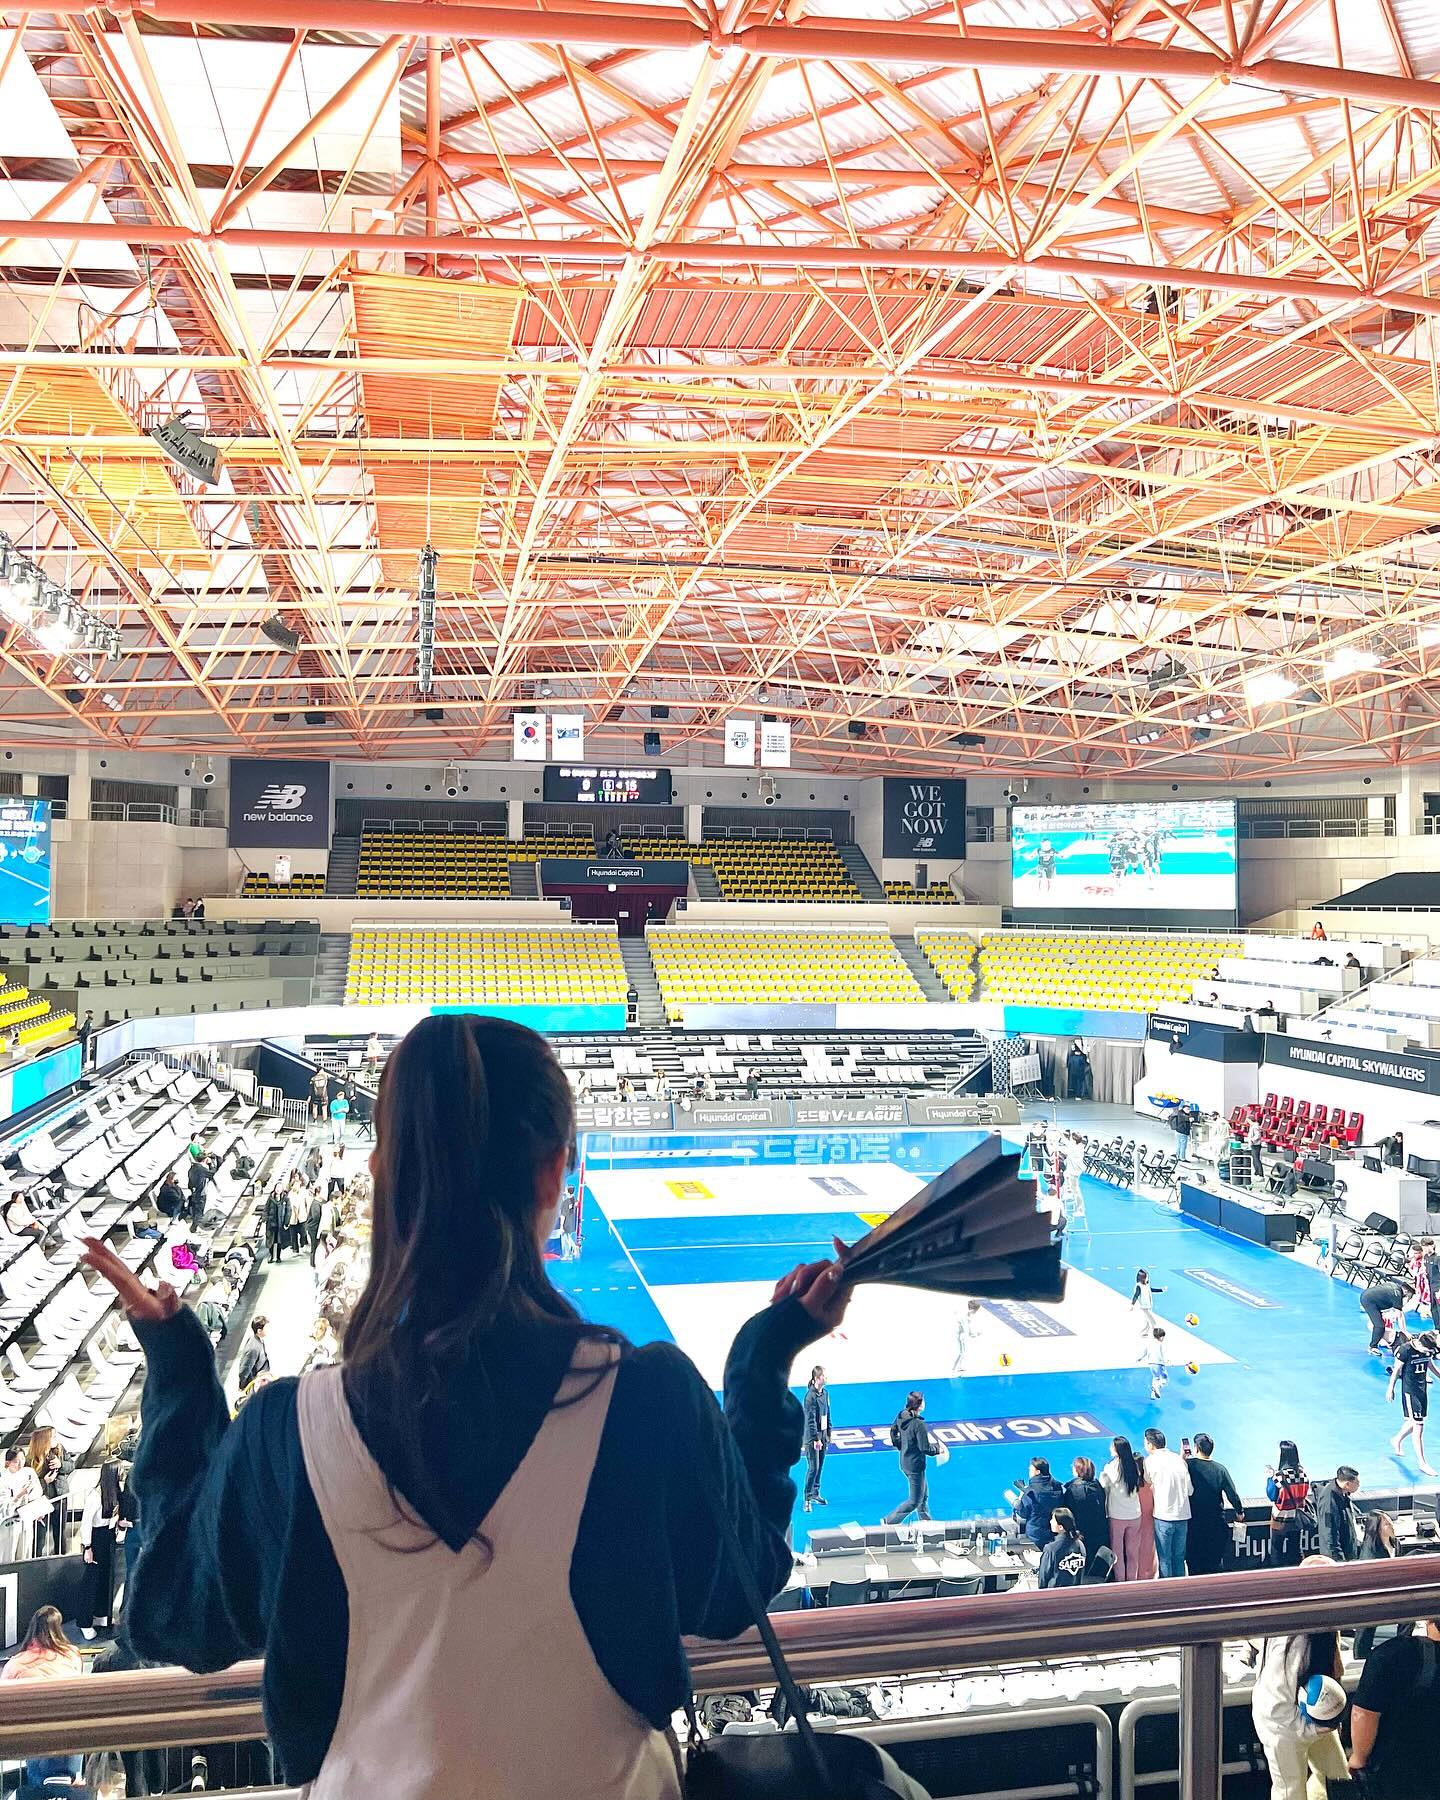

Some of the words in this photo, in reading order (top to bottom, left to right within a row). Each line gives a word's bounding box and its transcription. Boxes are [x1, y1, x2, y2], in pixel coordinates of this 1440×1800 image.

[909, 785, 941, 801] WE
[243, 813, 267, 821] new
[268, 812, 314, 822] balance
[904, 802, 946, 818] GOT
[901, 818, 948, 835] NOW
[591, 869, 617, 878] Hyundai
[617, 869, 640, 878] Capital
[1289, 1046, 1326, 1064] HYUNDAI
[1326, 1053, 1361, 1071] CAPITAL
[1361, 1059, 1426, 1082] SKYWALKERS
[576, 1106, 651, 1127] 드람한돈
[699, 1112, 735, 1124] Hyundai
[736, 1111, 767, 1122] Capital
[932, 1105, 967, 1119] Hyundai
[1415, 1363, 1426, 1373] 11
